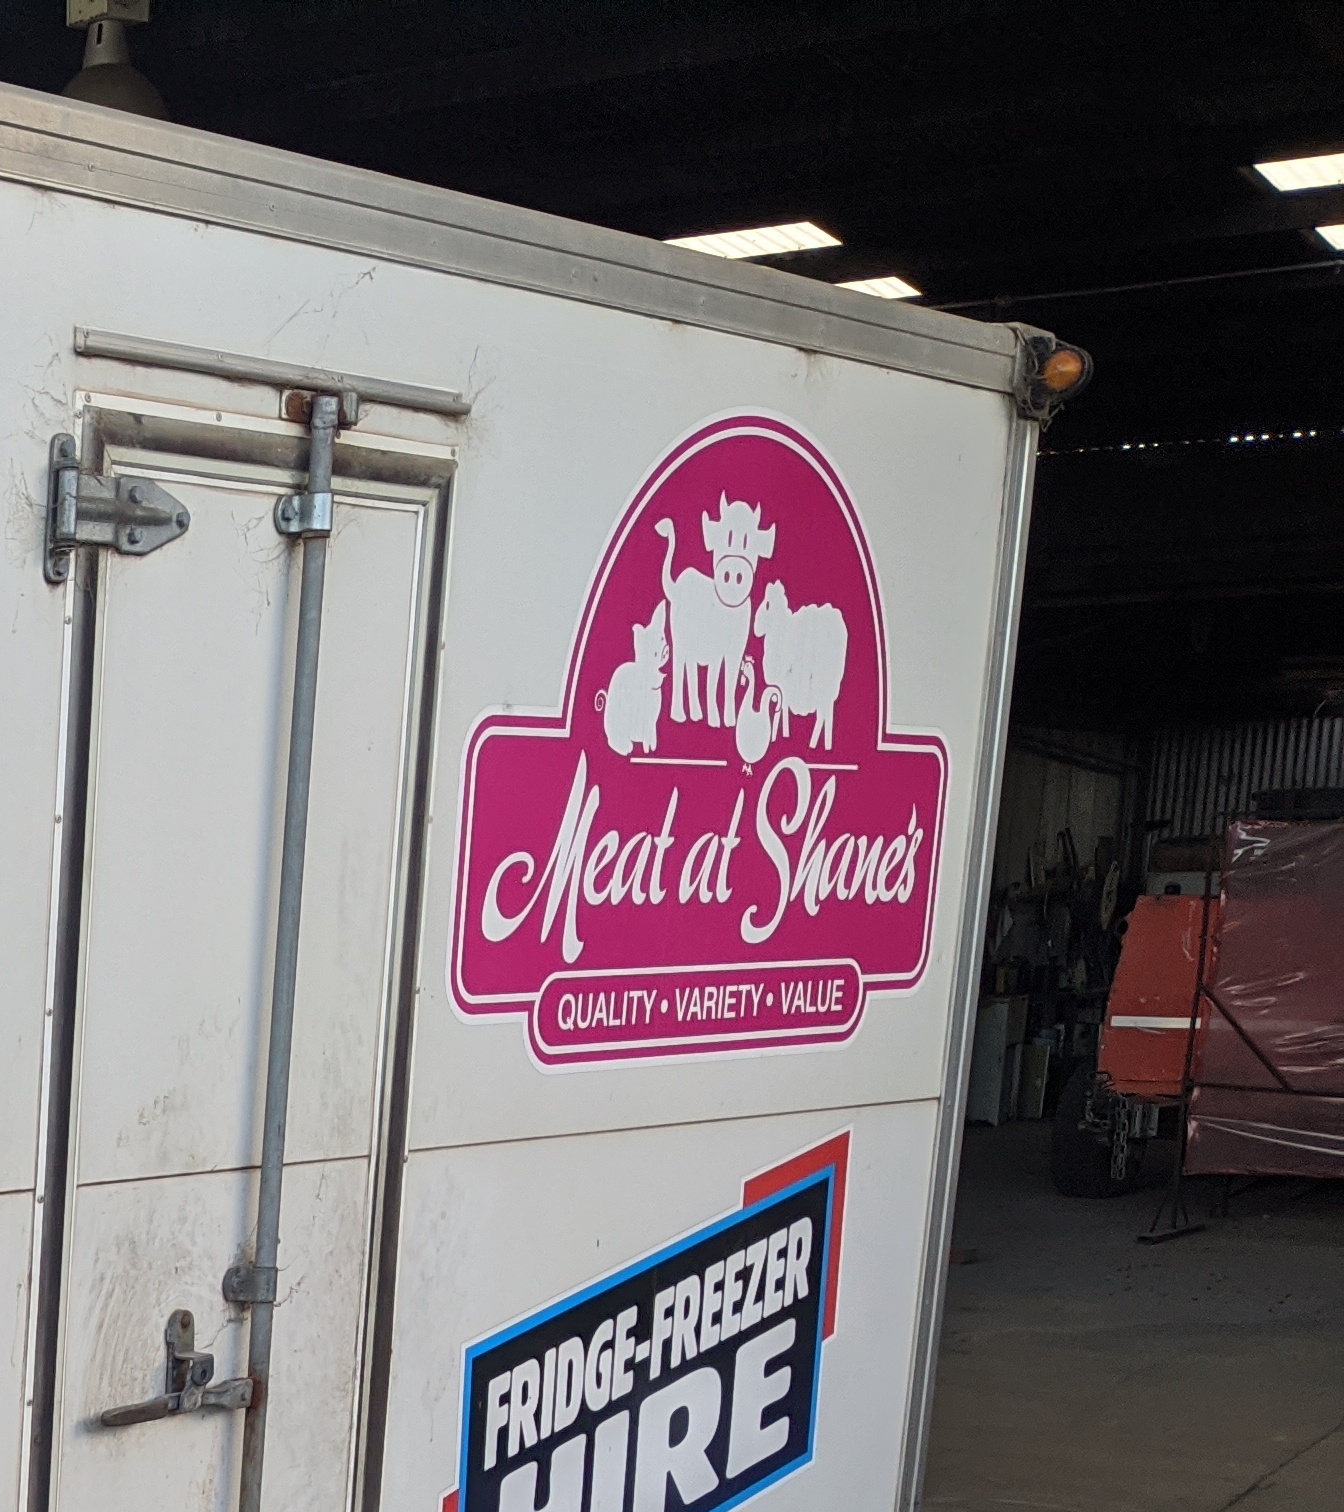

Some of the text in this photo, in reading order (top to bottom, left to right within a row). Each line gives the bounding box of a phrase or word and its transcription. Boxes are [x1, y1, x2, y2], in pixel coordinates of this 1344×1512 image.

[481, 749, 924, 963] Meat at Shane's
[557, 979, 845, 1032] QUALITY VARIETY VALUE
[483, 1215, 814, 1472] FRIDGE-FREEZER
